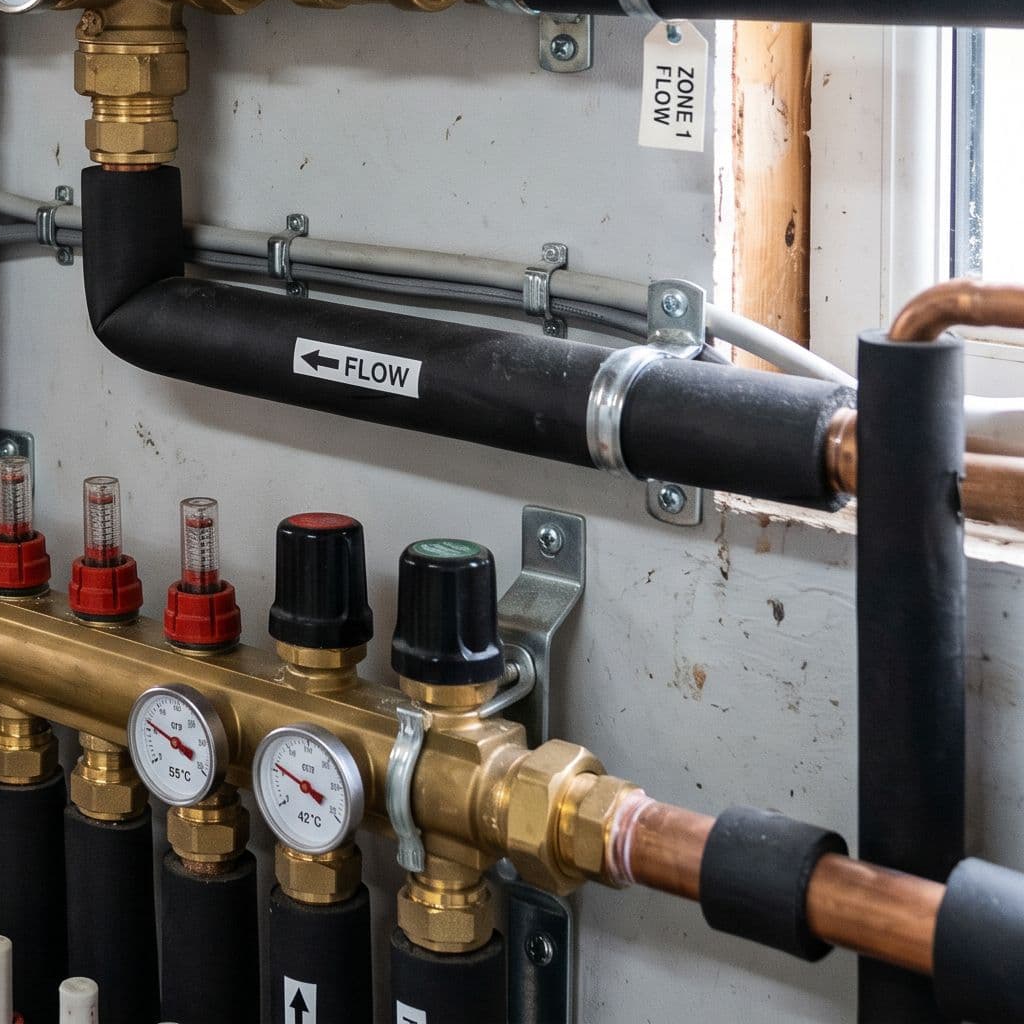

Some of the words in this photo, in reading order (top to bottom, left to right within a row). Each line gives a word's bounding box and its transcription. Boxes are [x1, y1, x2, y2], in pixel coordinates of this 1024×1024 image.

[653, 65, 672, 126] FLOW
[675, 67, 695, 124] ZONE
[675, 130, 692, 140] 1
[344, 356, 410, 388] FLOW
[297, 810, 322, 828] 42°C
